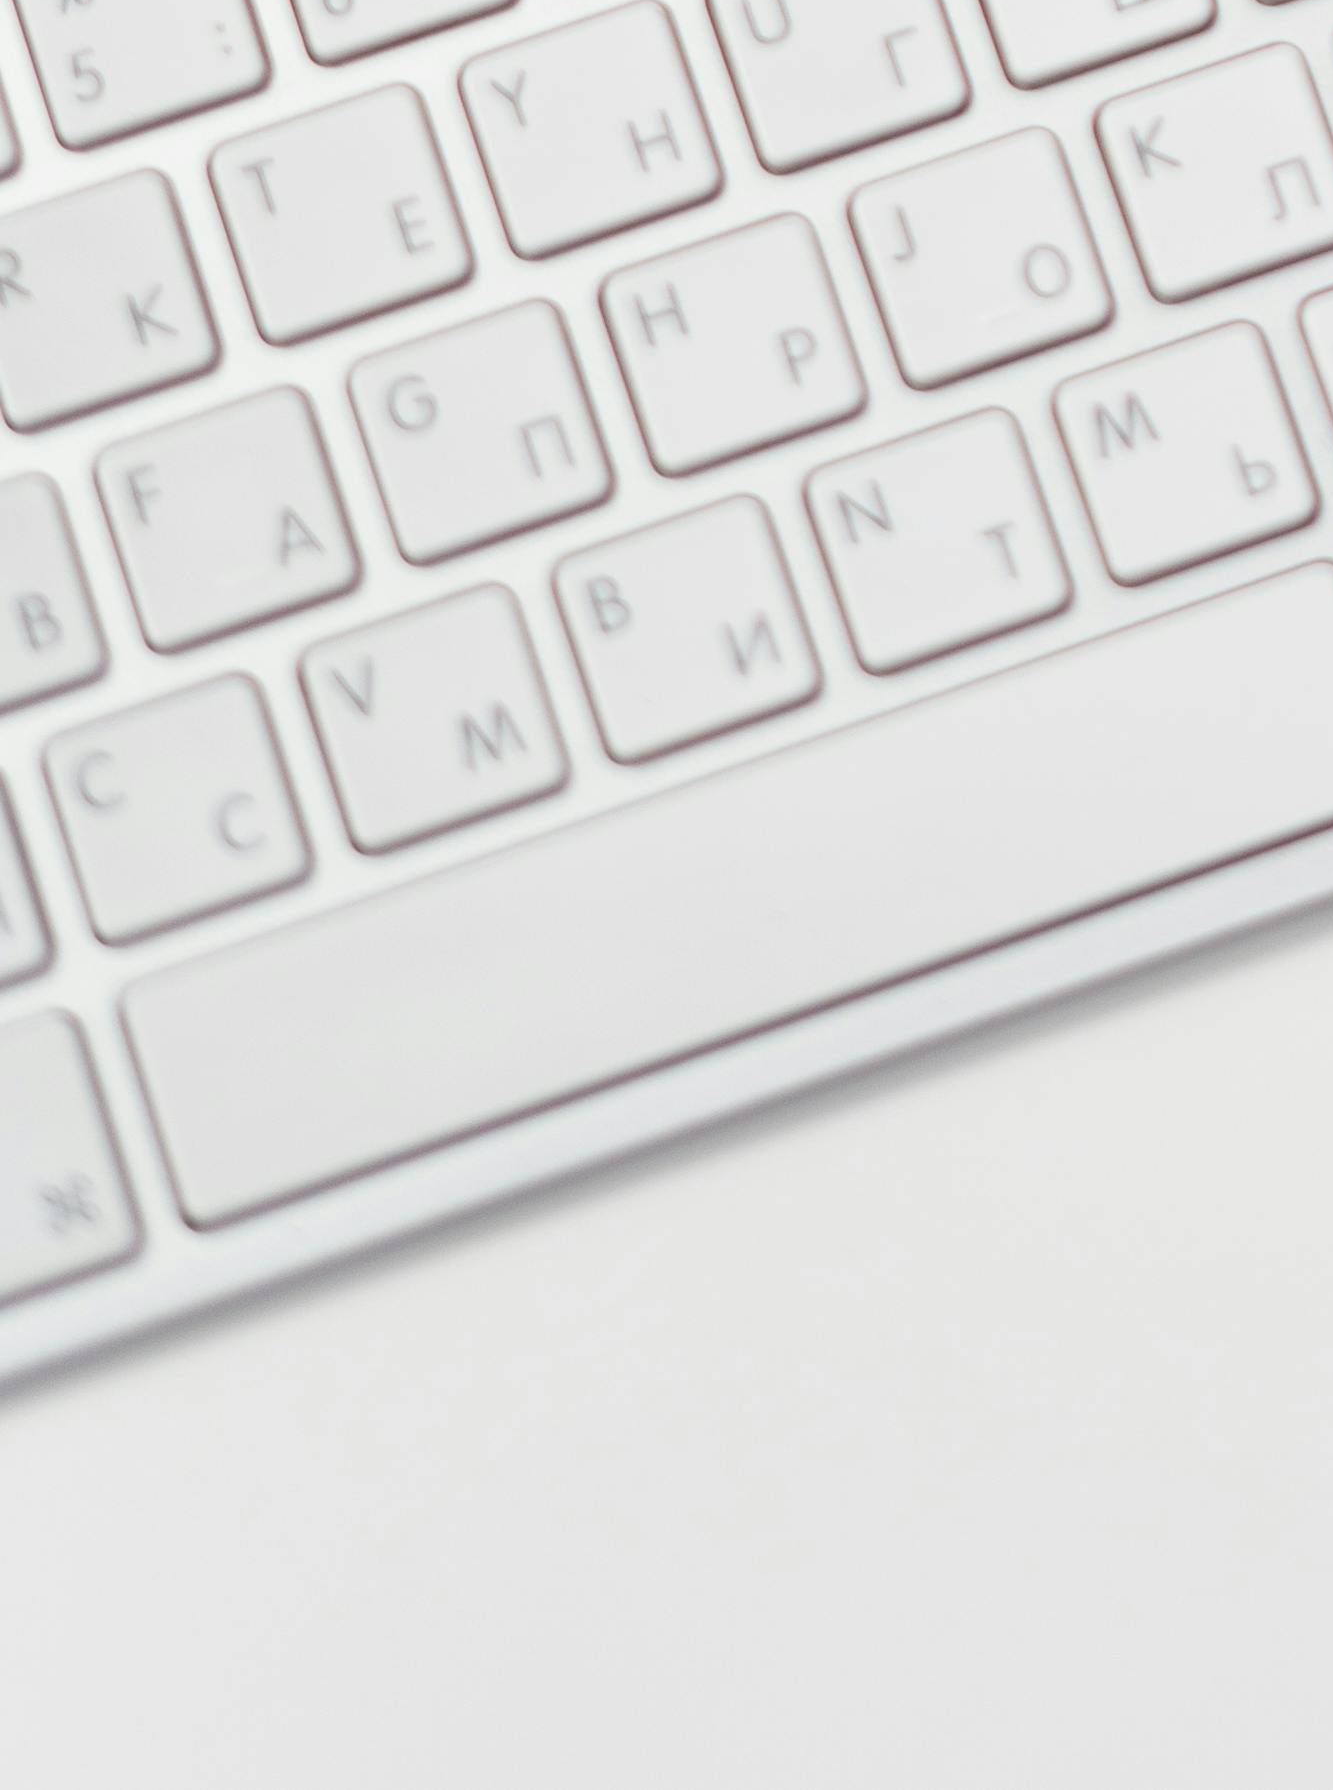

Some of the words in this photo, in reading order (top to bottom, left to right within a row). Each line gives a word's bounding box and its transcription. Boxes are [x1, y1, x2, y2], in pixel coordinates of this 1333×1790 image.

[70, 49, 106, 103] 5
[881, 26, 916, 88] Г
[489, 71, 527, 128] Y
[1129, 119, 1181, 178] K
[240, 158, 277, 216] T
[1264, 156, 1322, 223] Л
[894, 206, 917, 264] J
[633, 283, 690, 347] H
[385, 374, 439, 434] G
[1092, 392, 1160, 458] M
[517, 415, 575, 479] П
[1232, 446, 1278, 499] Ь
[125, 465, 158, 525] F
[835, 482, 894, 544] N
[585, 576, 632, 635] B
[723, 612, 783, 677] И
[331, 661, 373, 717] V
[73, 750, 123, 813] C
